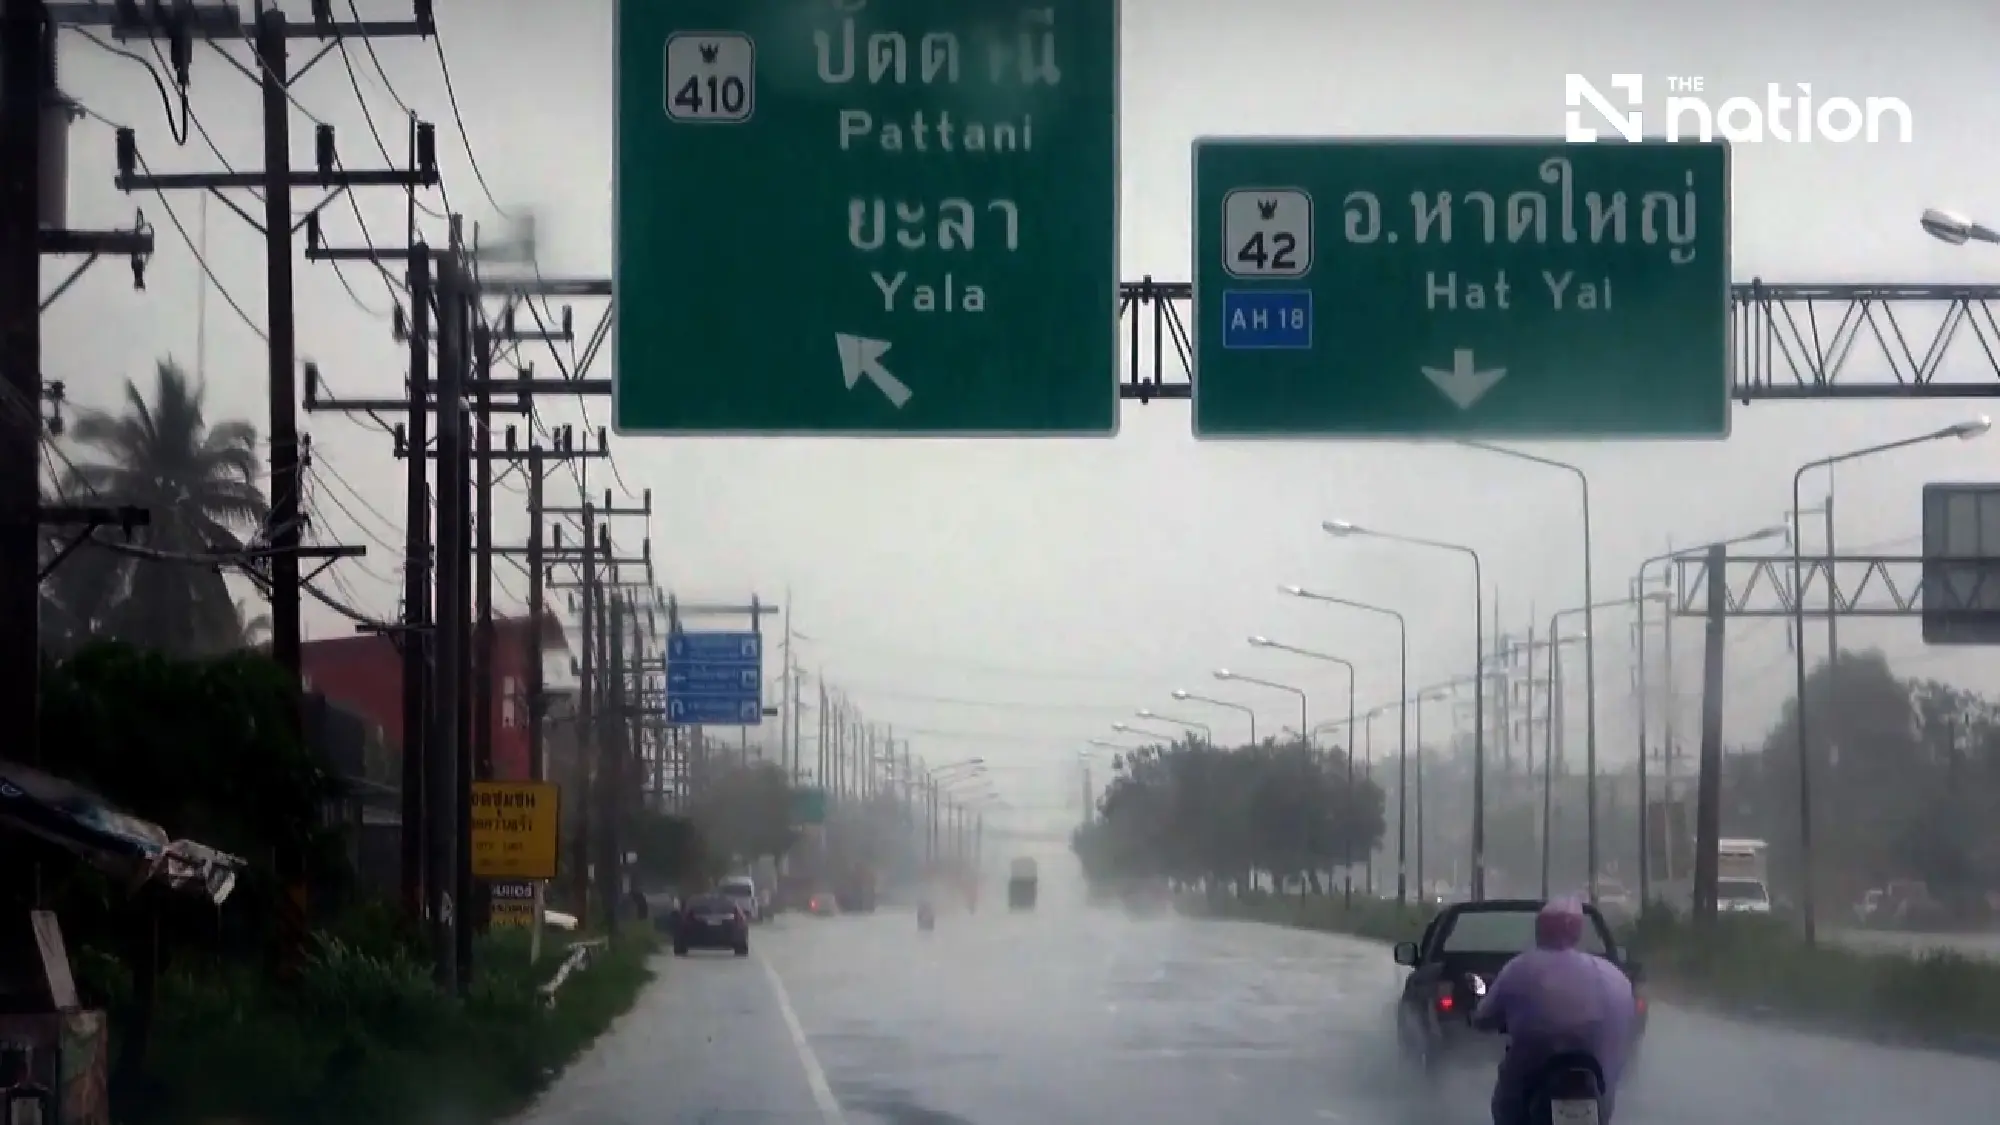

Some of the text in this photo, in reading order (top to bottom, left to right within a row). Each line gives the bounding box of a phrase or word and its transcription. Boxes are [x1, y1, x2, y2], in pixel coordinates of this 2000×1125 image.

[674, 75, 744, 113] 410
[839, 110, 1033, 151] Pattani
[848, 198, 1019, 251] ยะลา
[1344, 156, 1697, 264] อ.หาดใหญ่
[1237, 231, 1297, 270] 42
[871, 271, 986, 313] Yala
[1426, 270, 1613, 311] Hat Yai
[1231, 306, 1304, 331] AH 18
